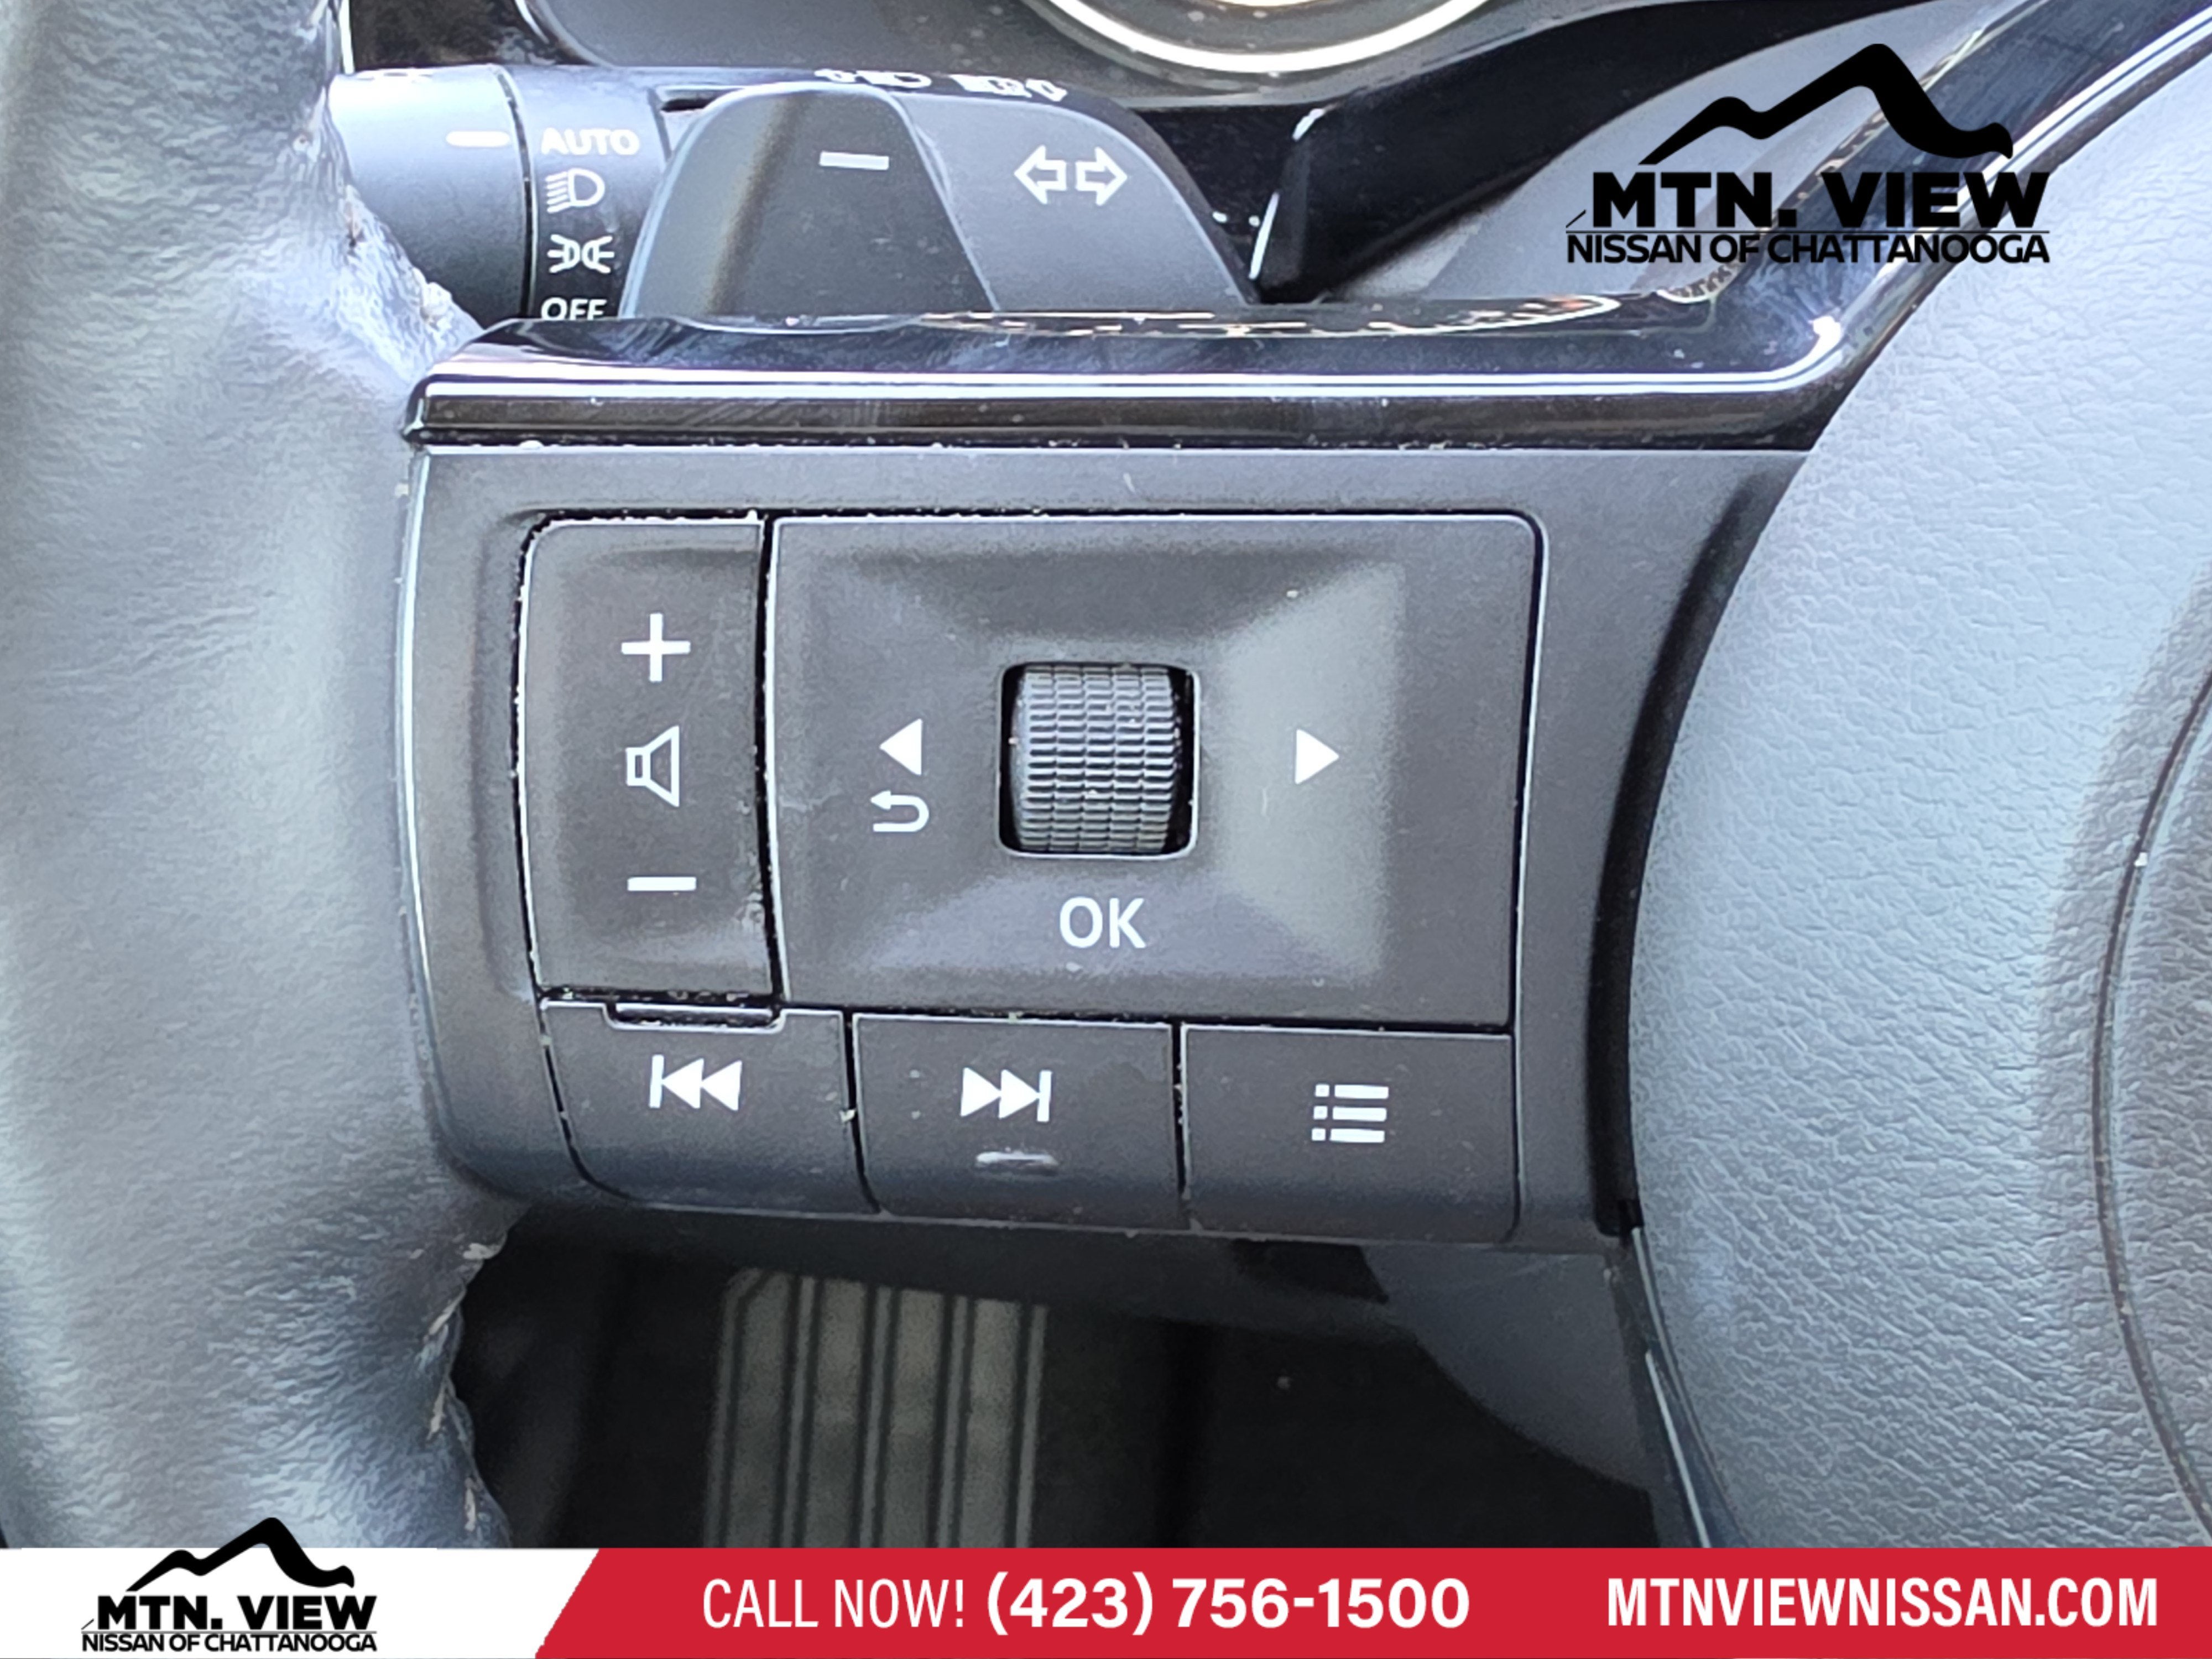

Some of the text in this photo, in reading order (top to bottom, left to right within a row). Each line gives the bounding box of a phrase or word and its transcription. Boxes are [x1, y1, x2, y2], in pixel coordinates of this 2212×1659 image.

[541, 127, 640, 155] AUTO
[541, 297, 607, 321] OFF
[1060, 896, 1146, 948] OK
